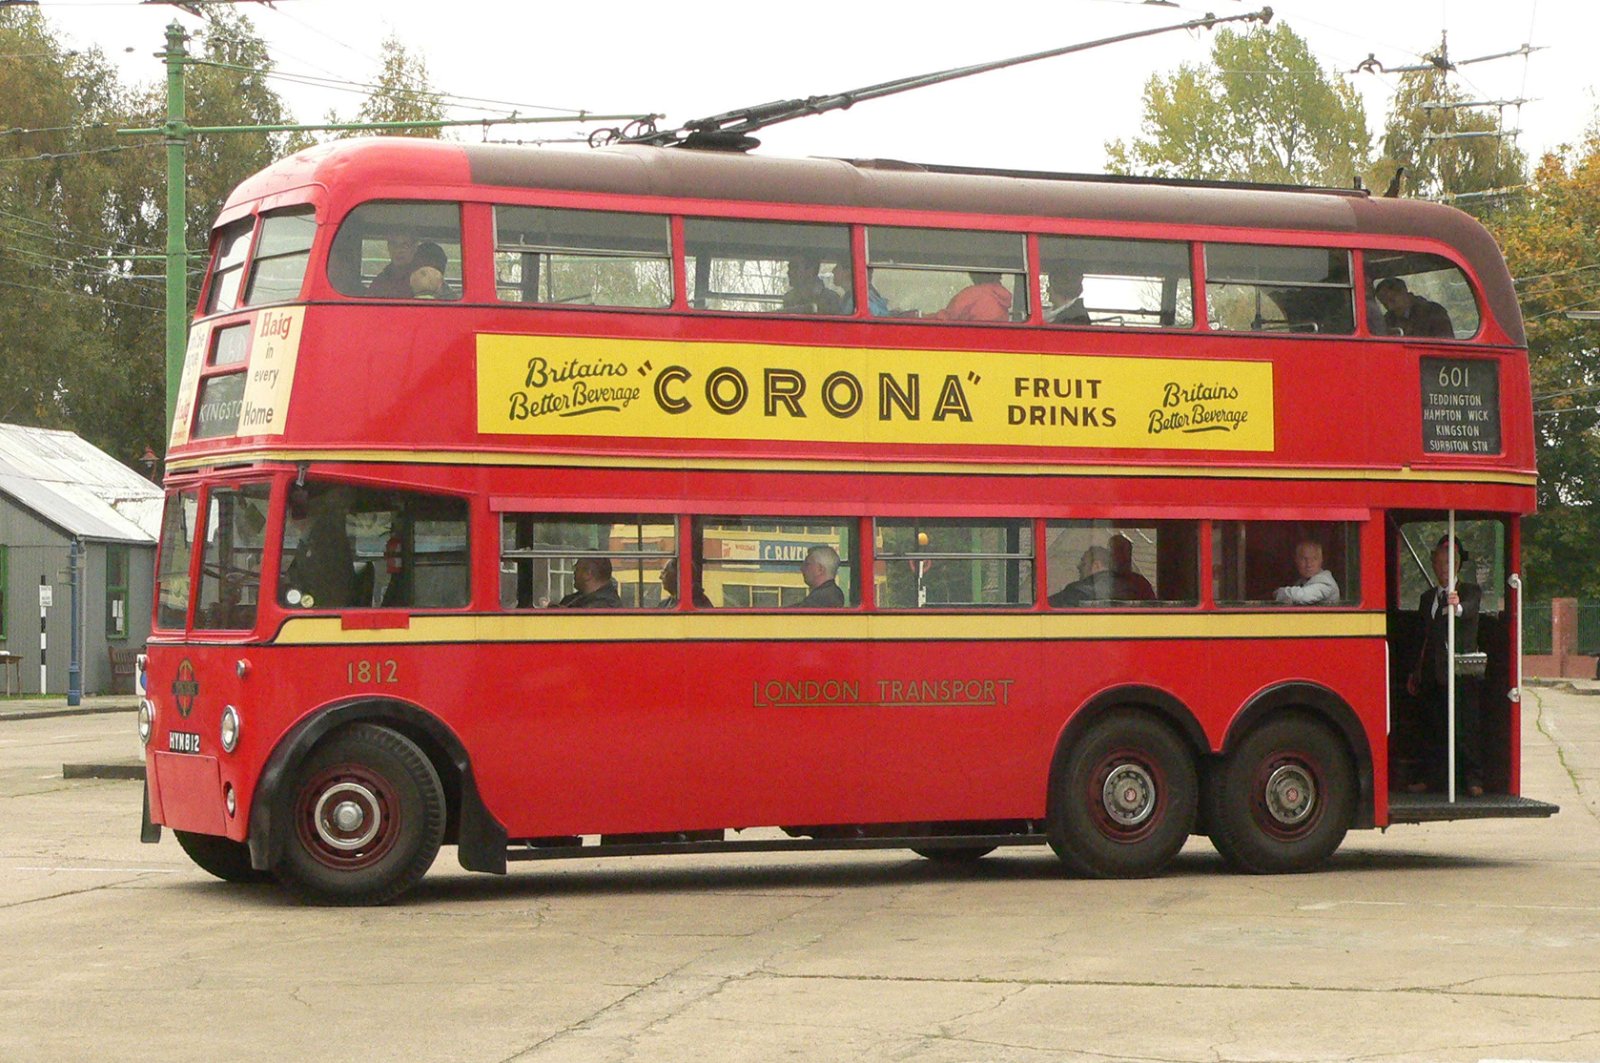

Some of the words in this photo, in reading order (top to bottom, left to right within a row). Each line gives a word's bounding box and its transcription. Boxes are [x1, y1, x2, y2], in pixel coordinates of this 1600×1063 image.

[260, 312, 292, 340] Haig
[265, 342, 274, 359] in
[254, 369, 279, 389] every
[525, 357, 628, 388] Britains
[1439, 366, 1469, 387] 601
[1014, 377, 1102, 399] FRUIT
[1163, 382, 1239, 408] Britains
[509, 391, 570, 420] Better
[572, 381, 640, 408] Beverage
[1429, 394, 1482, 406] TEDDINGTON
[243, 401, 274, 426] Home
[1008, 405, 1116, 427] DRINKS
[1148, 409, 1190, 434] Better
[1192, 404, 1248, 430] Beverage
[1423, 409, 1462, 421] HAMPTON
[1468, 410, 1489, 422] WICK
[1436, 425, 1480, 437] KINGSTON
[1430, 440, 1469, 451] SURBITON
[1472, 441, 1488, 452] STN
[348, 659, 399, 684] 1812
[753, 679, 860, 707] LONDON
[877, 679, 1014, 705] TRANSPORT
